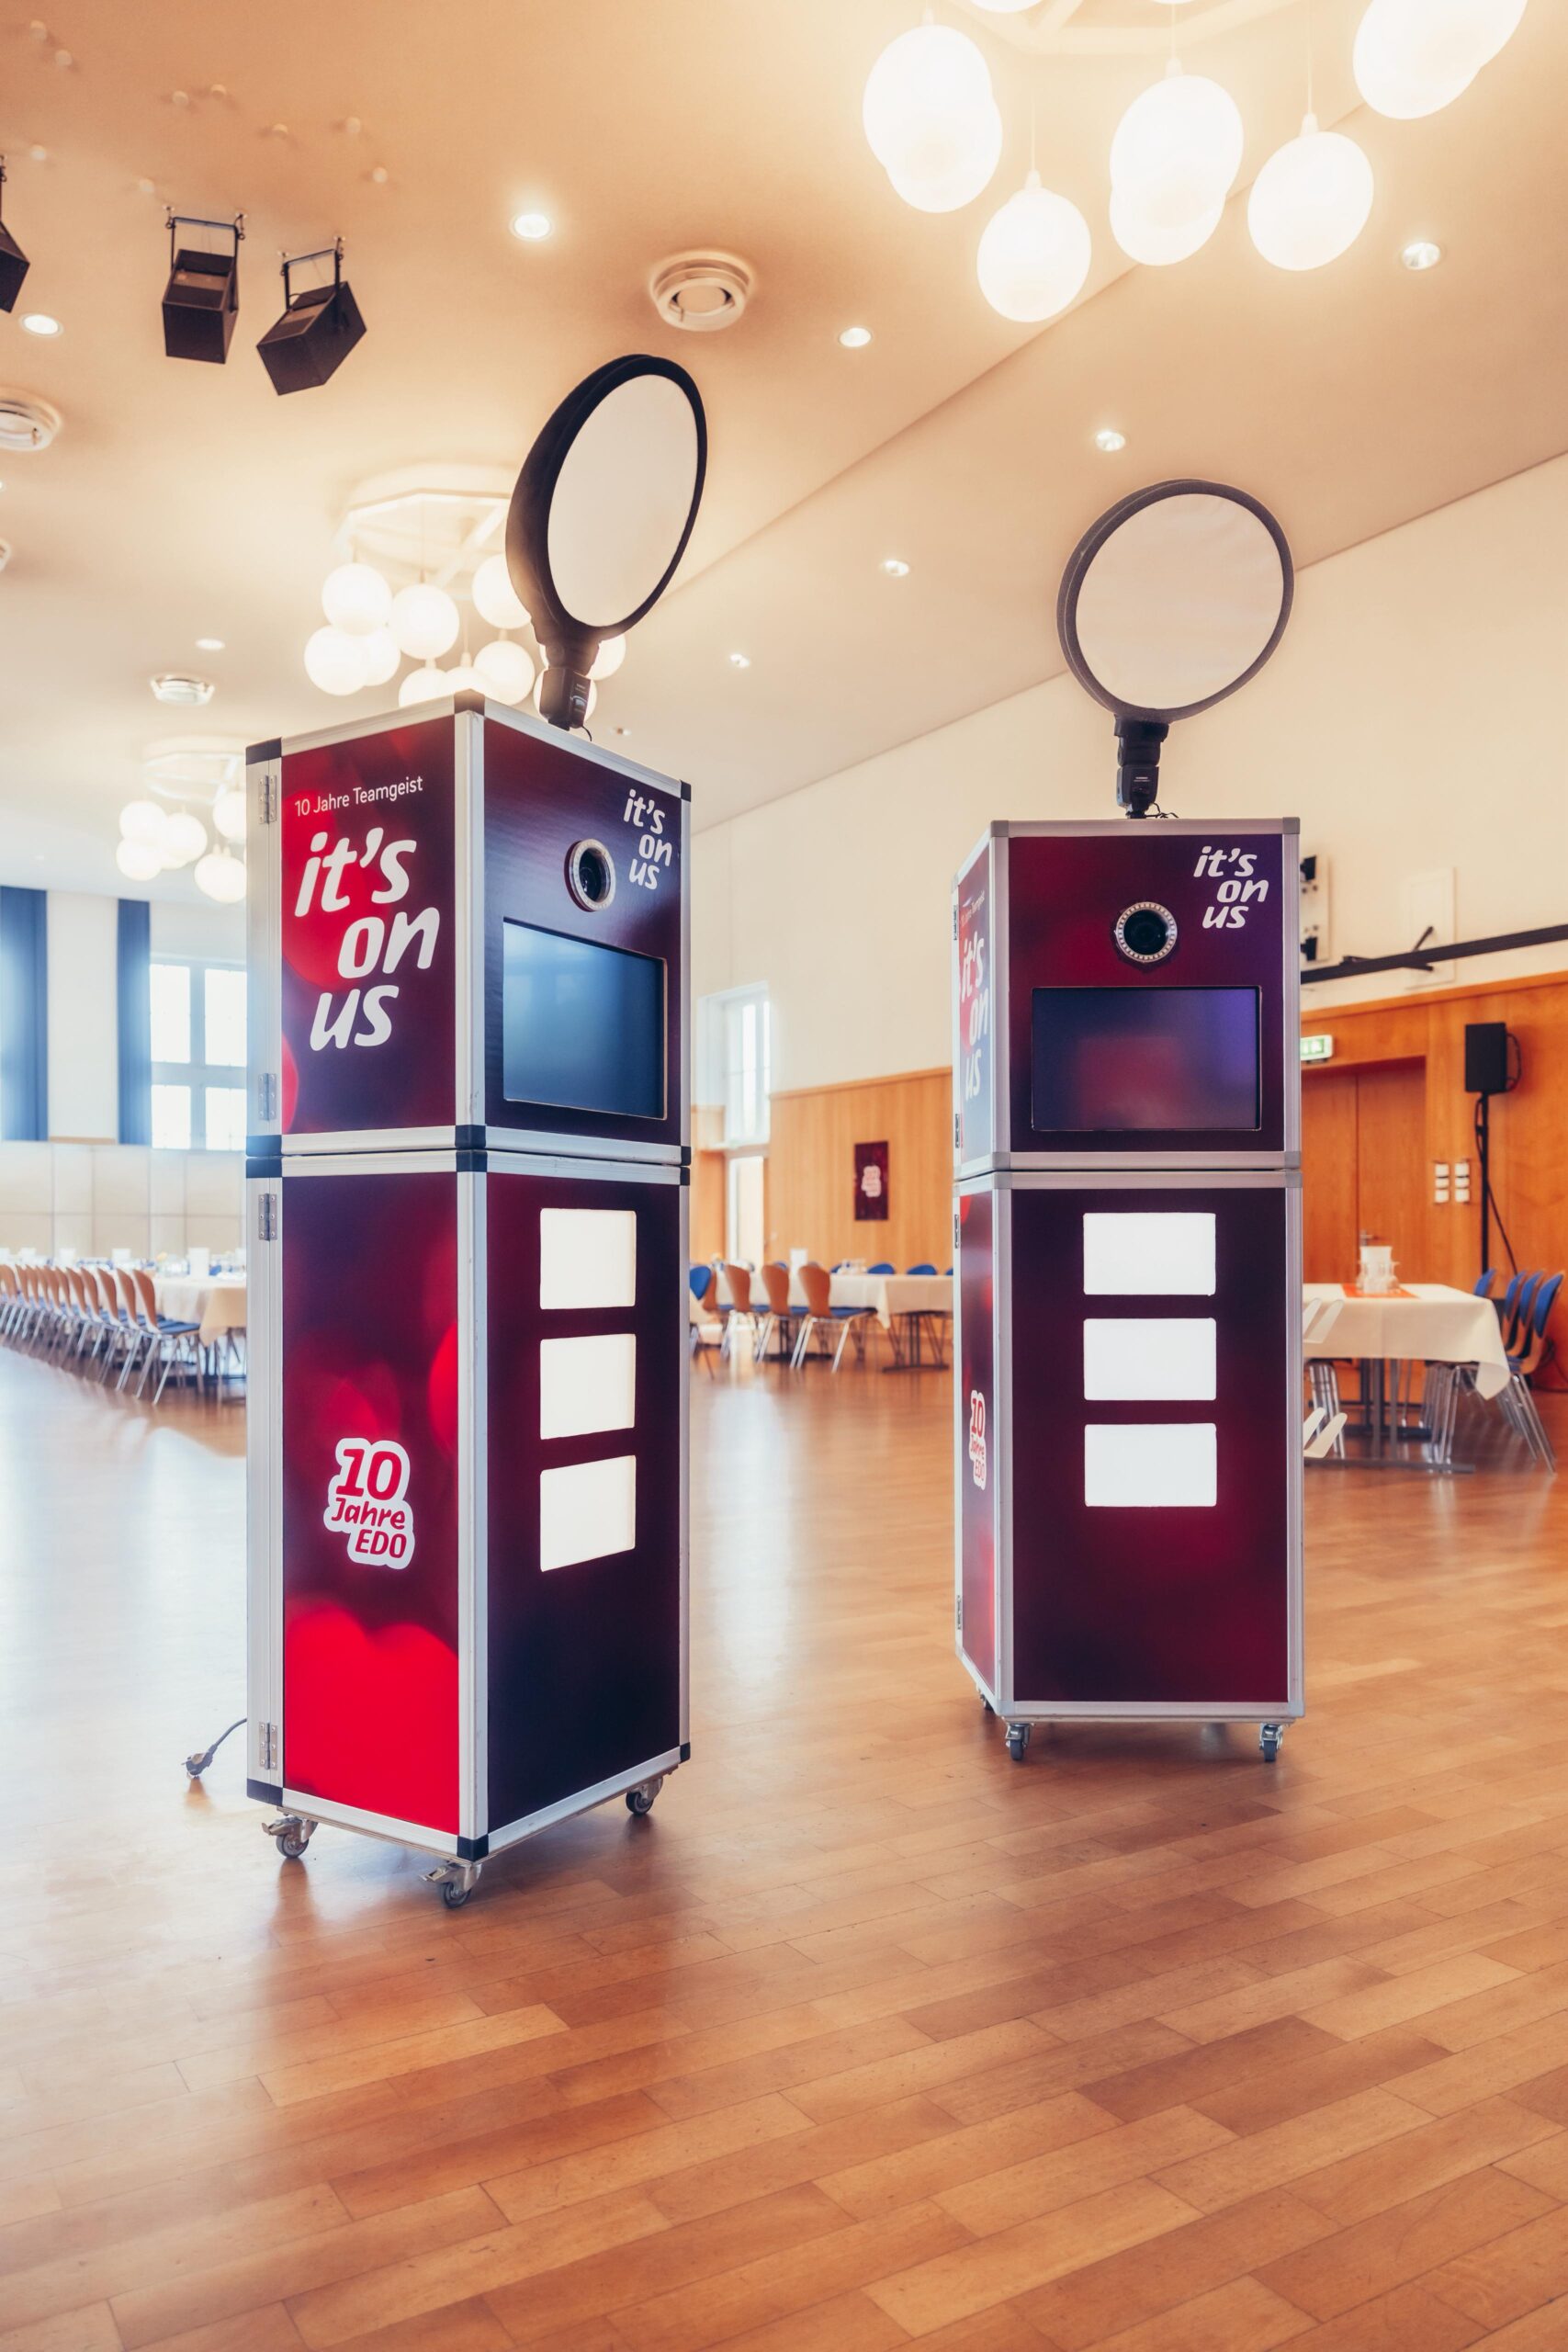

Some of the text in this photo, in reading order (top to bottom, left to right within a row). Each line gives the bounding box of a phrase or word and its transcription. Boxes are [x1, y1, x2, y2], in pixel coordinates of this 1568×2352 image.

[294, 775, 423, 817] 10 Jahre Teamgeist
[638, 834, 672, 866] on
[629, 858, 660, 890] us
[1216, 879, 1269, 903] on
[1201, 906, 1249, 929] us
[337, 907, 440, 979] on
[310, 985, 400, 1051] us
[969, 988, 988, 1046] on
[965, 1048, 982, 1101] us
[971, 1397, 984, 1438] 10
[335, 1448, 402, 1500] 10
[331, 1497, 406, 1530] Jahre
[355, 1529, 407, 1558] EDO
